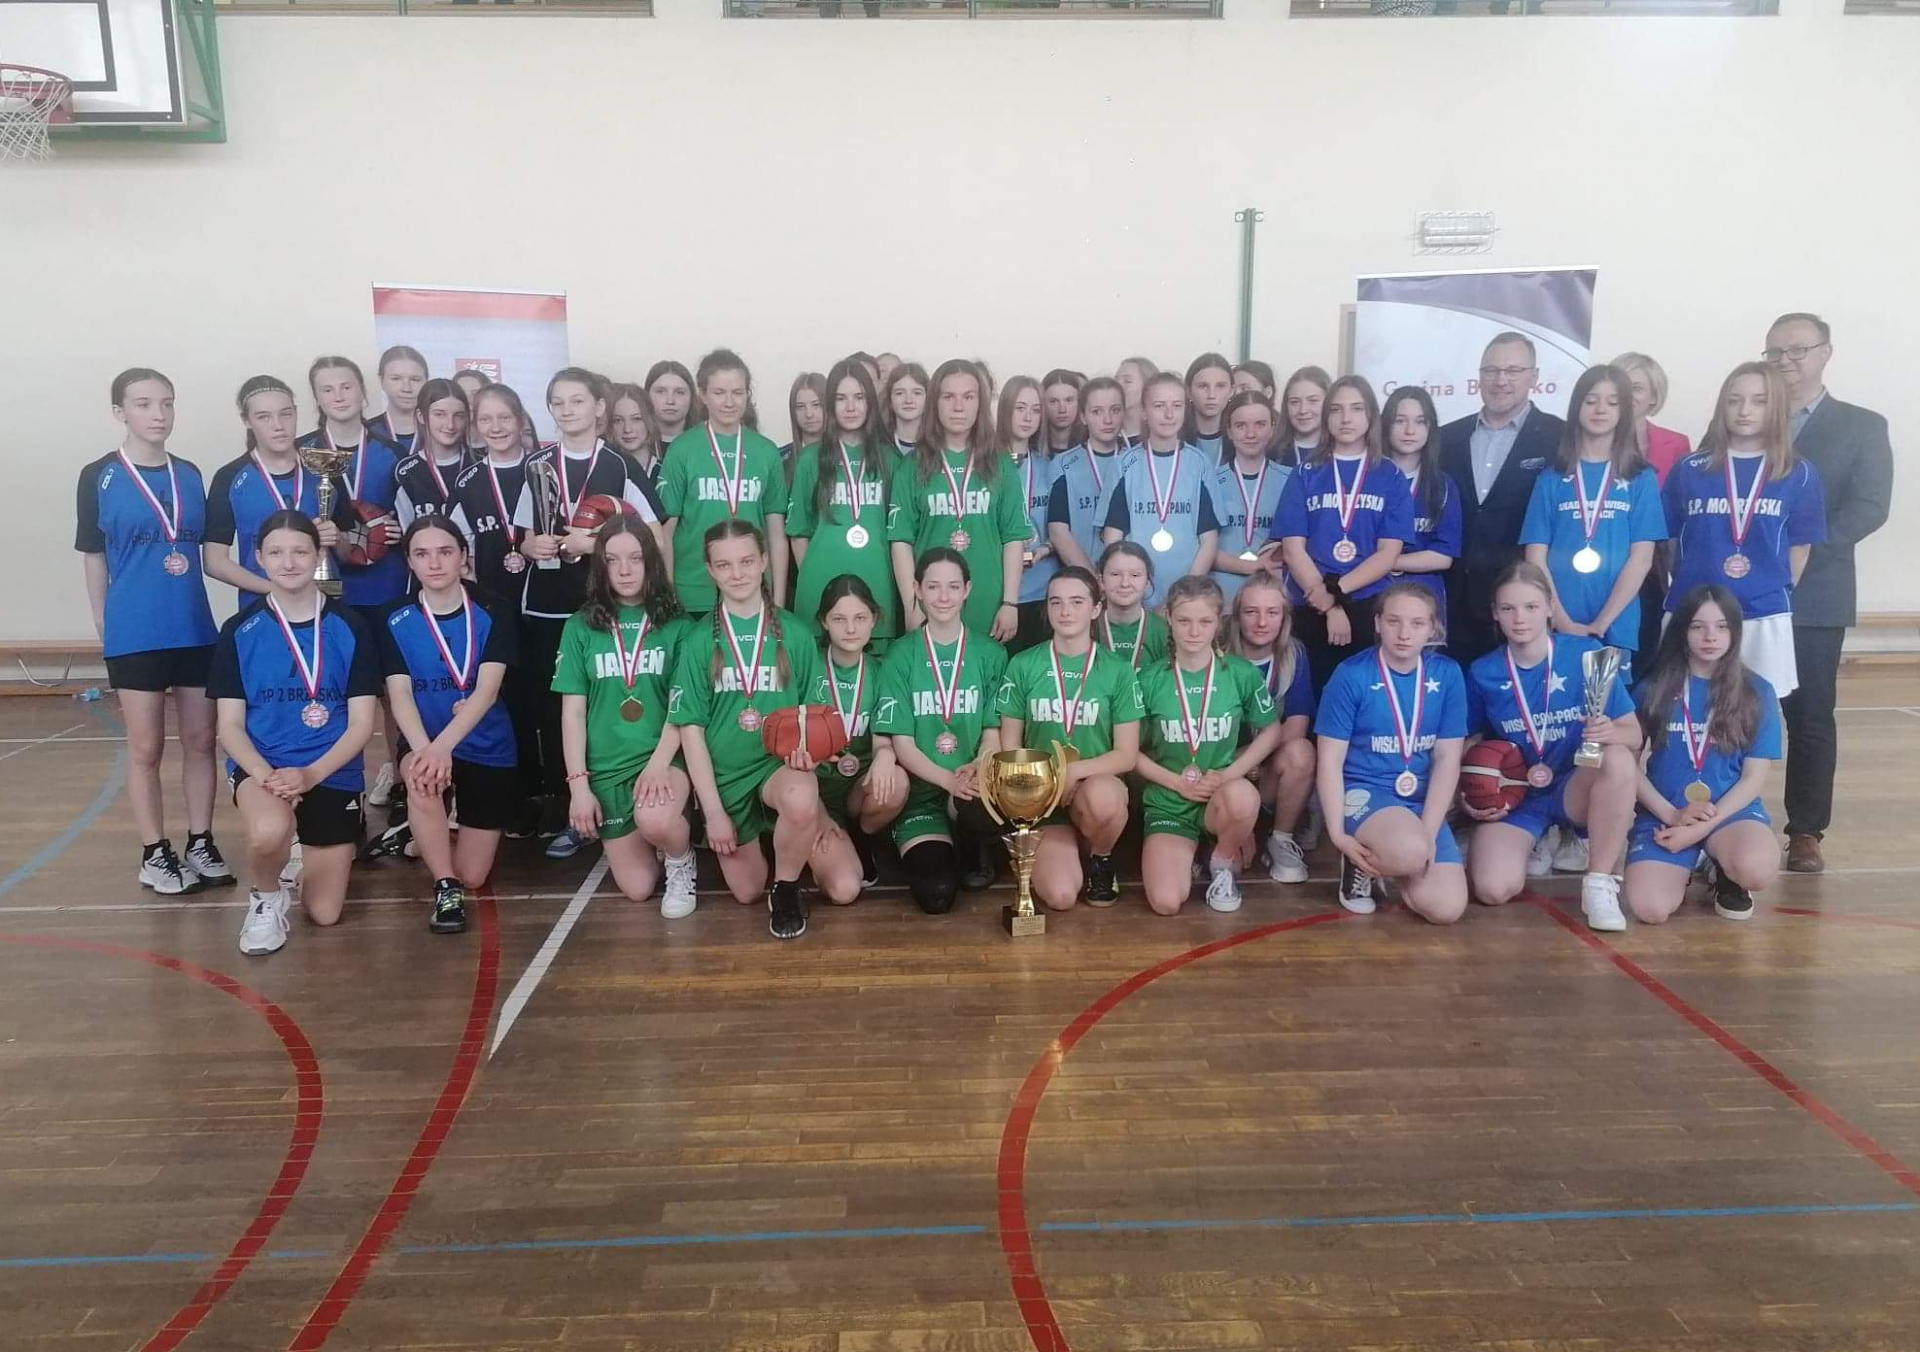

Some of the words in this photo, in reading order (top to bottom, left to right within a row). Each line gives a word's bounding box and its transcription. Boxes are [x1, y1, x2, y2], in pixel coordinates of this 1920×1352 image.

[1383, 379, 1455, 397] Gina
[698, 476, 762, 502] JASEŃ
[927, 487, 991, 516] JASEŃ
[477, 515, 500, 533] S.P.
[595, 646, 665, 679] JASEŃ
[912, 685, 979, 717] JASEŃ
[1031, 697, 1099, 726] JASEŃ
